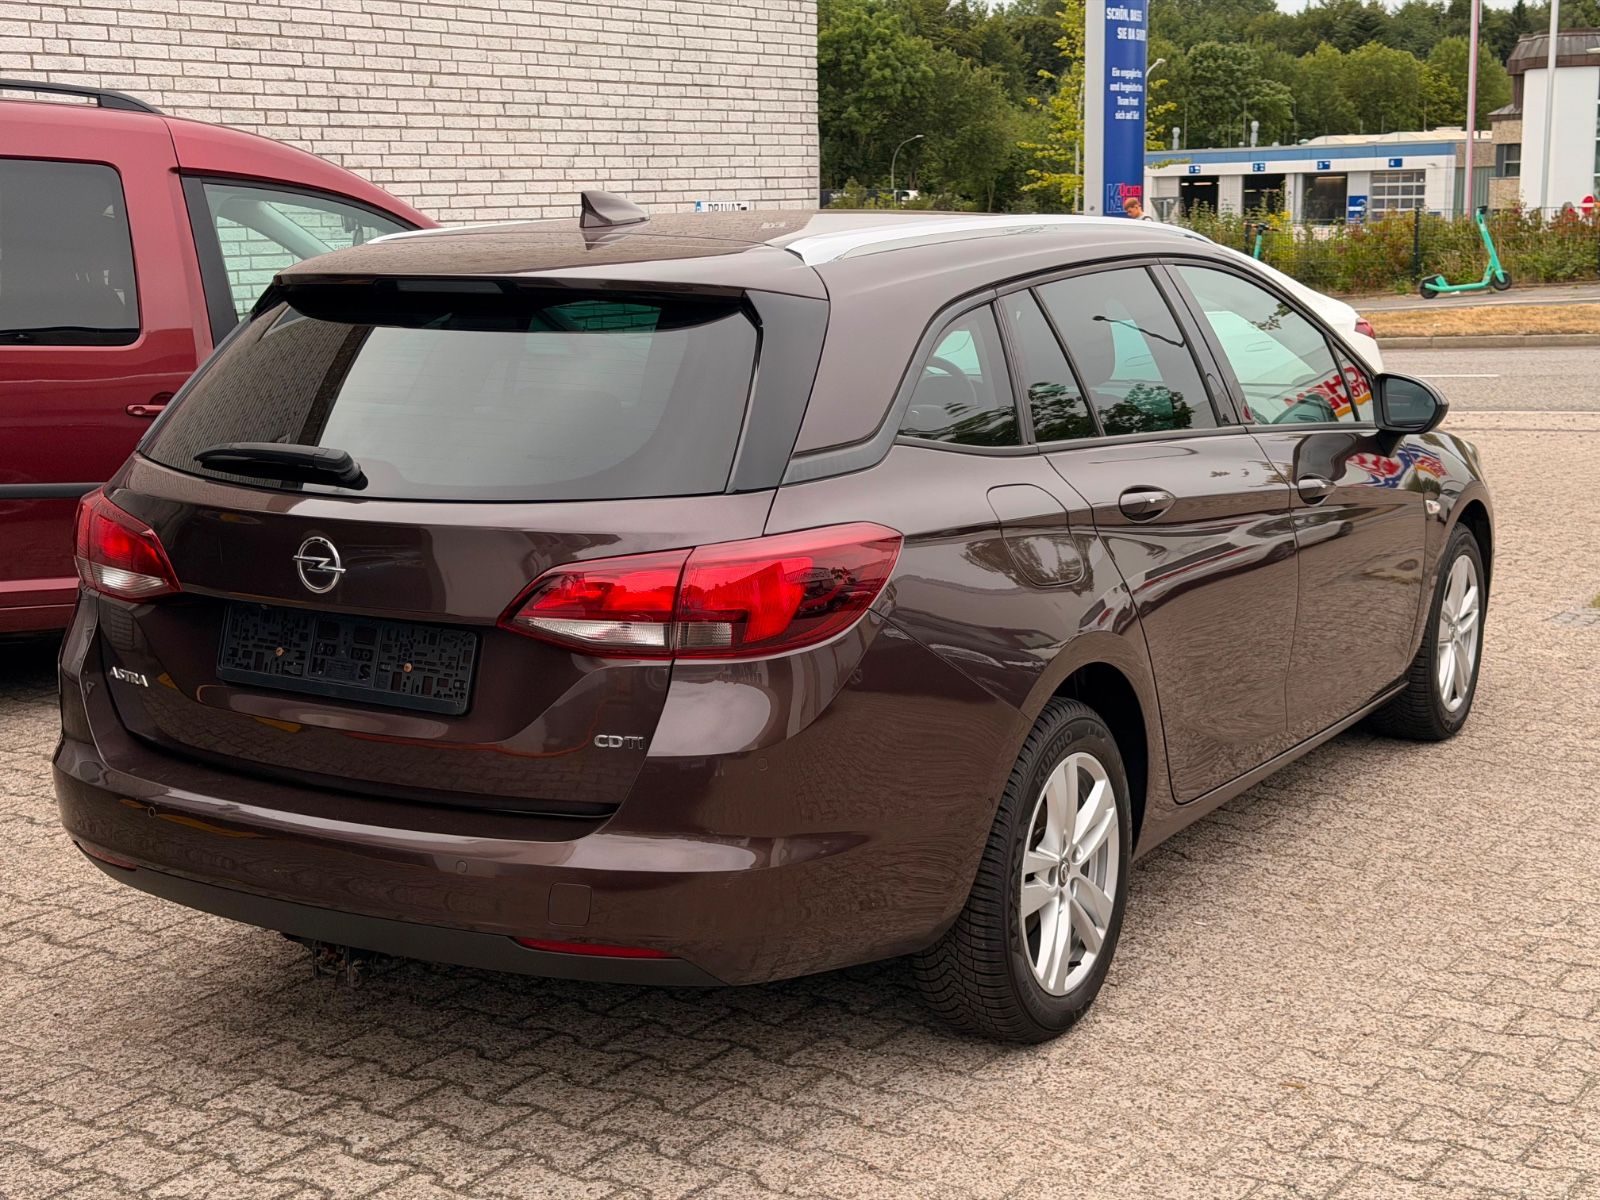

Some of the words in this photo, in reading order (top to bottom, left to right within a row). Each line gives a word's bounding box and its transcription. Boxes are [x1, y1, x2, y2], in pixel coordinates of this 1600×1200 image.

[109, 666, 148, 687] ASTRA
[594, 734, 644, 750] CDTI
[1035, 729, 1073, 786] KUMHO
